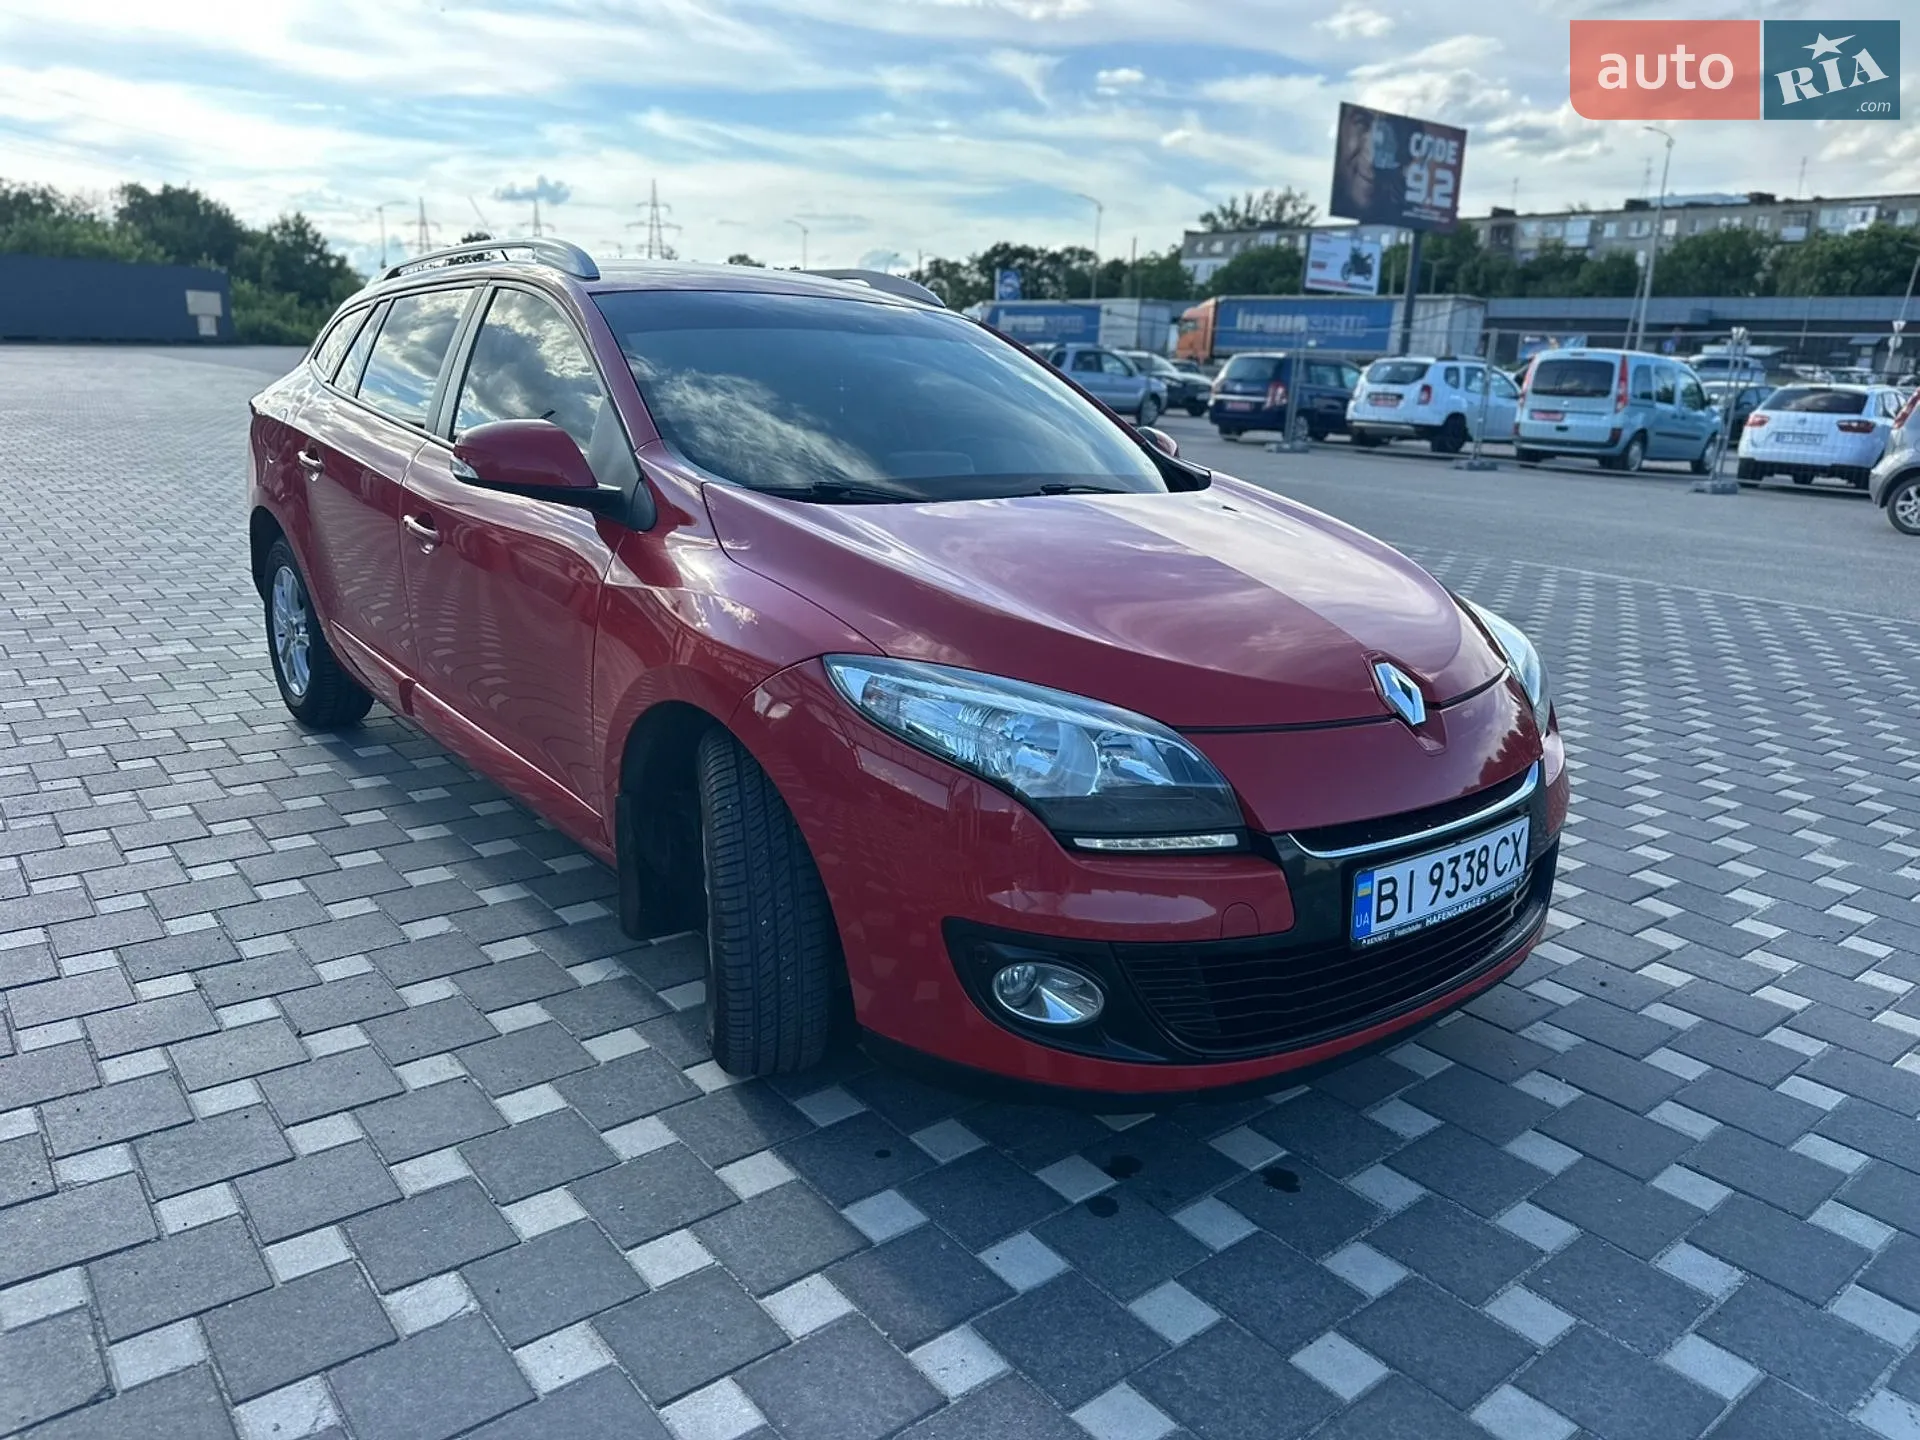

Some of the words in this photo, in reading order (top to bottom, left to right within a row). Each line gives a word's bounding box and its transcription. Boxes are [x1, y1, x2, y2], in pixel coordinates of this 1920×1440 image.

[1375, 869, 1414, 924] BI
[1428, 844, 1490, 907] 9338
[1493, 827, 1525, 878] CX
[1355, 913, 1370, 928] UA
